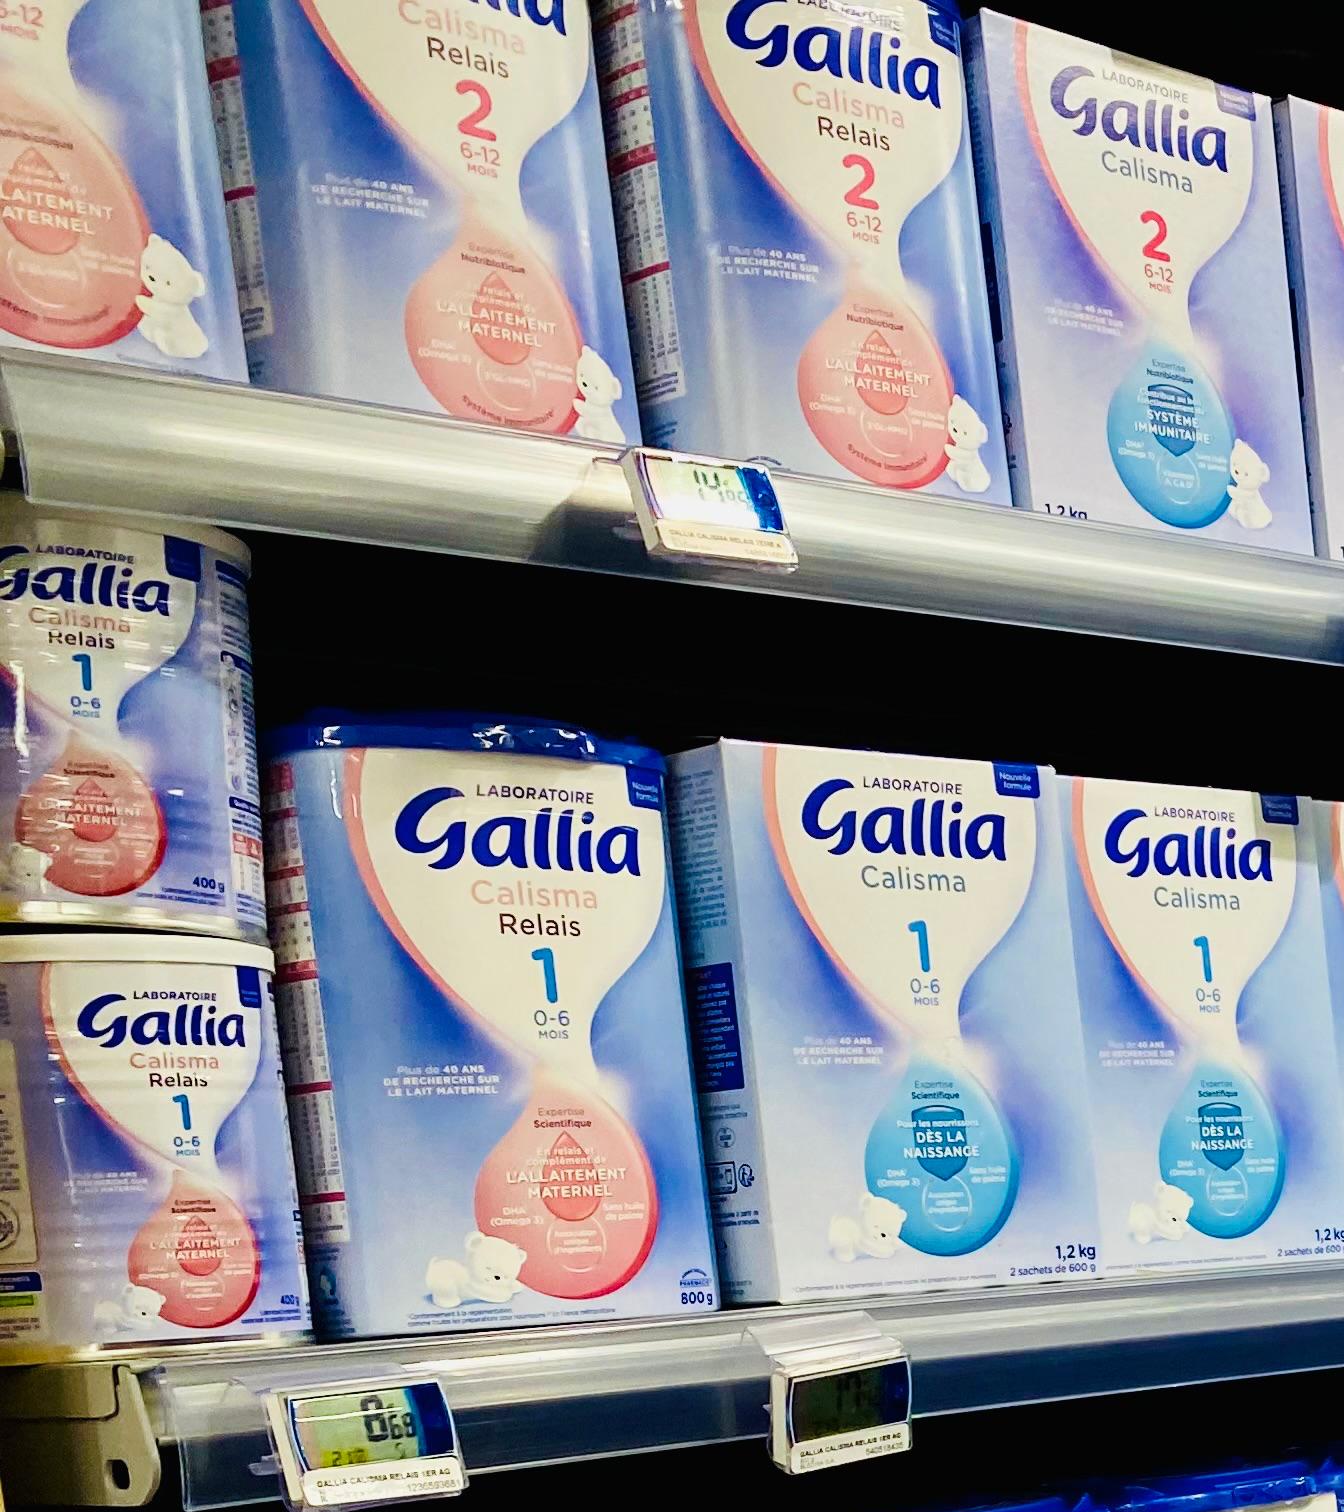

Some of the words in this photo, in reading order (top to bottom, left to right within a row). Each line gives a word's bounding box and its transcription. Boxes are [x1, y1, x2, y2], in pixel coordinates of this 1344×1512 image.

[427, 37, 510, 78] Relais
[725, 0, 941, 109] Gallia
[1101, 69, 1189, 104] LABORATOIRE
[792, 82, 905, 129] Calisma
[1049, 66, 1229, 173] Gallia
[818, 116, 891, 151] Relais
[460, 141, 501, 166] 6-12
[1101, 152, 1194, 195] Calisma
[1141, 211, 1171, 262] 2
[1144, 265, 1174, 283] 6-12
[437, 300, 557, 335] L'ALLAITEMENT
[458, 320, 542, 347] MATERNEL
[1147, 409, 1199, 430] SYSTÈME
[1134, 421, 1211, 445] IMMUNITAIRE
[28, 607, 131, 633] Calisma
[476, 783, 594, 805] LABORATOIRE
[863, 776, 963, 795] LABORATOIRE
[394, 787, 640, 877] Gallia
[801, 779, 1007, 862] Gallia
[1104, 809, 1273, 882] Gallia
[861, 866, 967, 893] Calisma
[470, 880, 598, 909] Calisma
[1154, 886, 1241, 911] Calisma
[499, 913, 581, 937] Relais
[908, 920, 931, 972] 1
[532, 948, 557, 1004] 1
[910, 979, 940, 995] 0-6
[133, 991, 217, 1002] LABORATOIRE
[77, 994, 246, 1049] Gallia
[534, 1010, 570, 1027] 0-6
[538, 1028, 569, 1040] MOIS
[130, 1051, 220, 1071] Calisma
[442, 1065, 457, 1074] 40
[460, 1065, 485, 1074] ANS
[149, 1072, 208, 1088] Relais
[402, 1075, 474, 1085] RECHERCHE
[477, 1074, 500, 1084] SUR
[406, 1086, 431, 1095] LAIT
[436, 1084, 499, 1095] MATERNEL
[534, 1118, 592, 1129] Scientifique
[916, 1127, 943, 1144] DÈS
[947, 1130, 964, 1143] LA
[903, 1144, 980, 1160] NAISSANCE
[506, 1167, 627, 1184] L'ALLAITEMENT
[528, 1184, 612, 1199] MATERNEL
[1055, 1244, 1075, 1261] 1,2
[1079, 1243, 1096, 1260] kg
[1010, 1267, 1016, 1276] 2
[1019, 1263, 1049, 1276] sachets
[1052, 1264, 1064, 1274] de
[1068, 1262, 1087, 1273] 600
[1090, 1263, 1096, 1275] g
